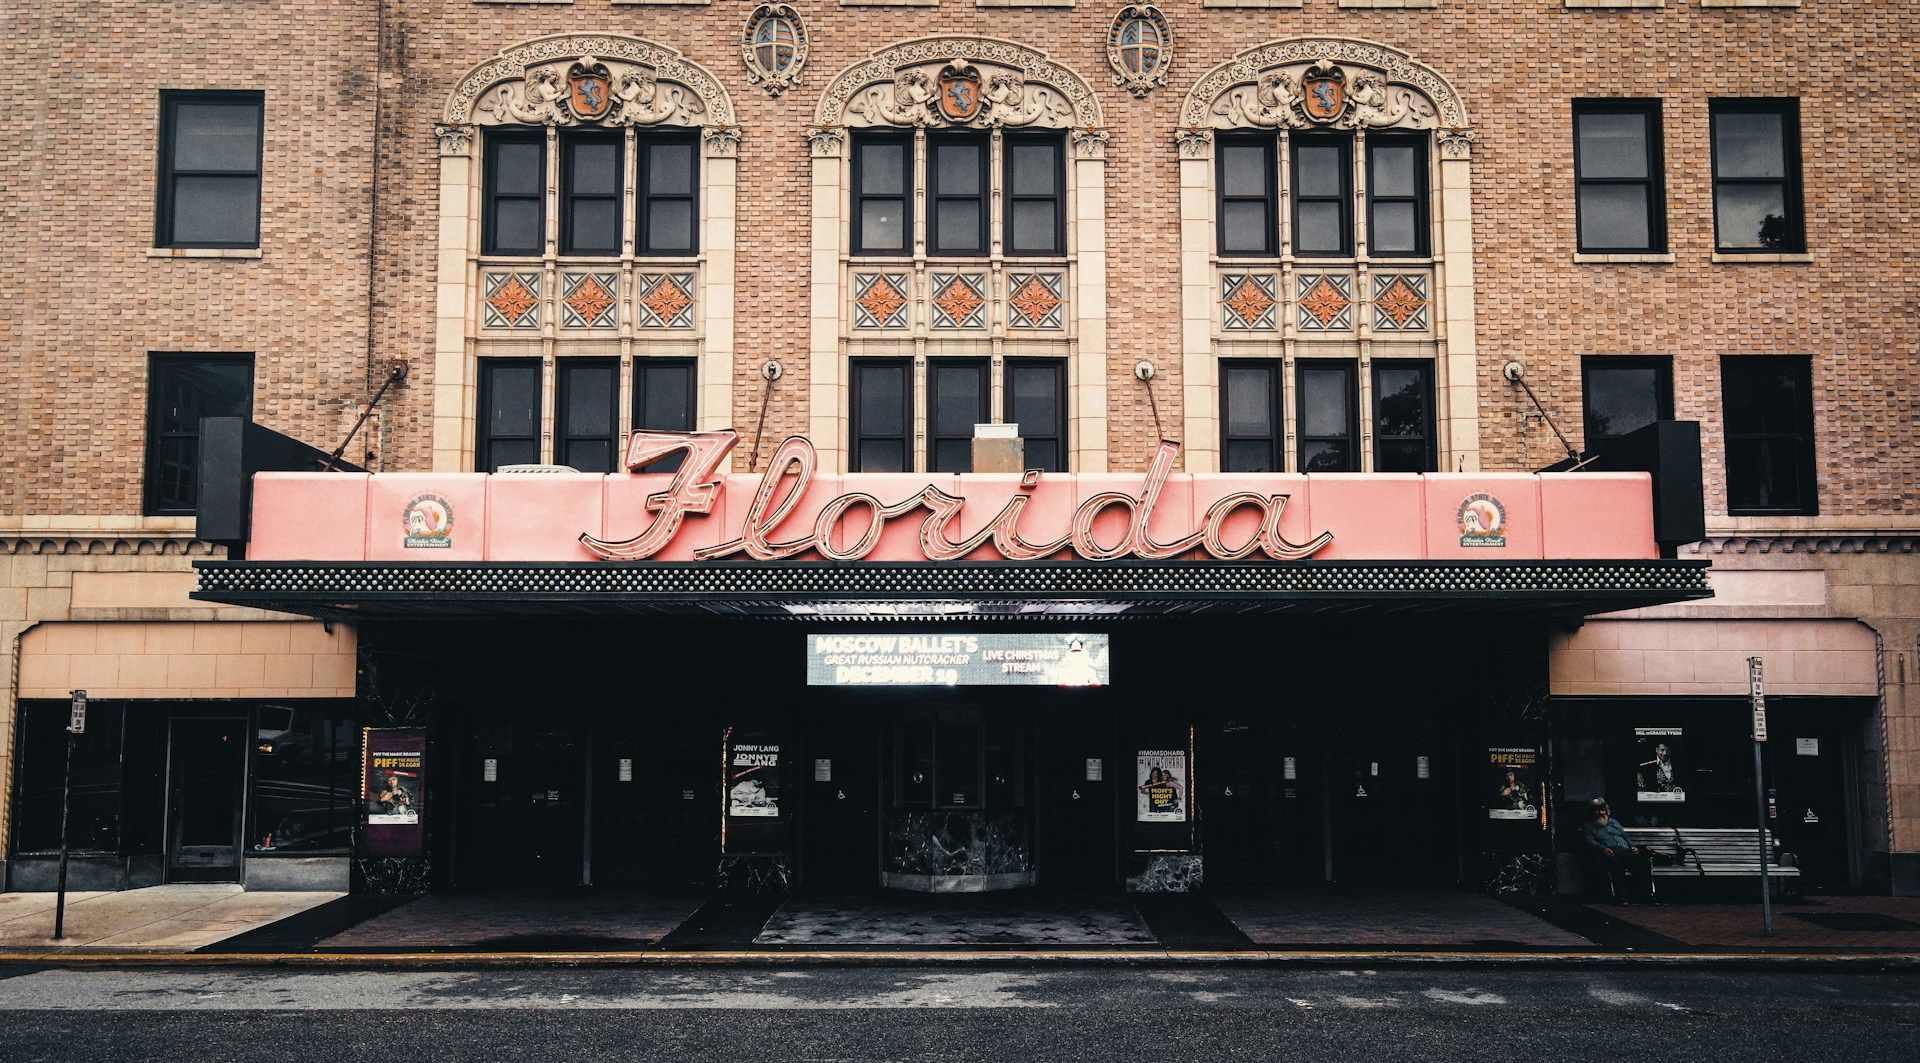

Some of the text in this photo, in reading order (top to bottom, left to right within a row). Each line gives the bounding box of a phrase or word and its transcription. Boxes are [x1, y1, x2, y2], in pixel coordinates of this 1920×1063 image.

[579, 429, 1335, 563] Florida
[816, 636, 979, 654] MOSCOW BALLET'S
[825, 654, 970, 665] GREAT RUSSIAN NUTCRACKER
[982, 650, 1005, 661] LIVE
[1001, 662, 1043, 673] STREAM
[836, 666, 934, 683] DECEMBER
[374, 758, 398, 768] PIFF
[1491, 754, 1514, 763] PIFF
